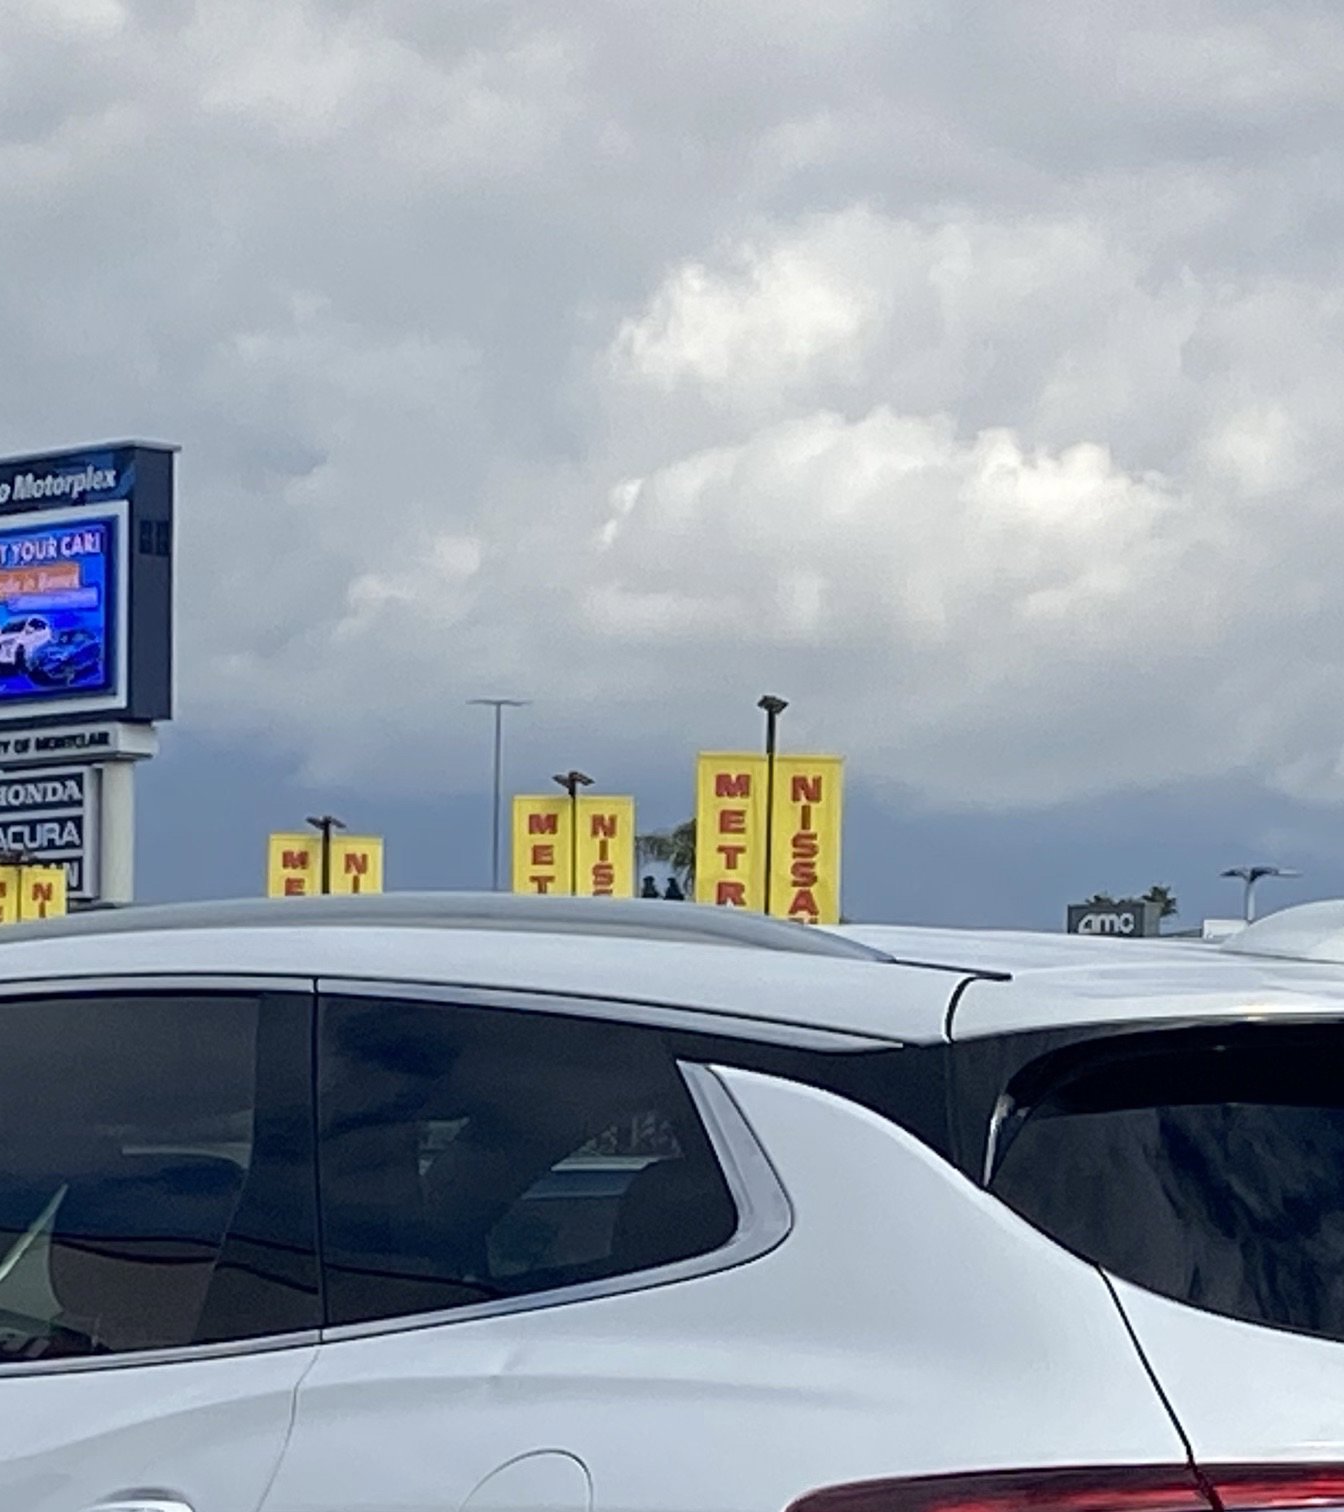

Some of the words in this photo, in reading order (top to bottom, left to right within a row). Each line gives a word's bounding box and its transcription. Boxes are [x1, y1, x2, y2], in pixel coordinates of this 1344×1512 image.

[12, 464, 116, 500] Motorplex
[11, 538, 57, 562] YOUR
[61, 532, 101, 558] CAR!
[14, 737, 31, 753] OF
[788, 775, 822, 924] NISSA
